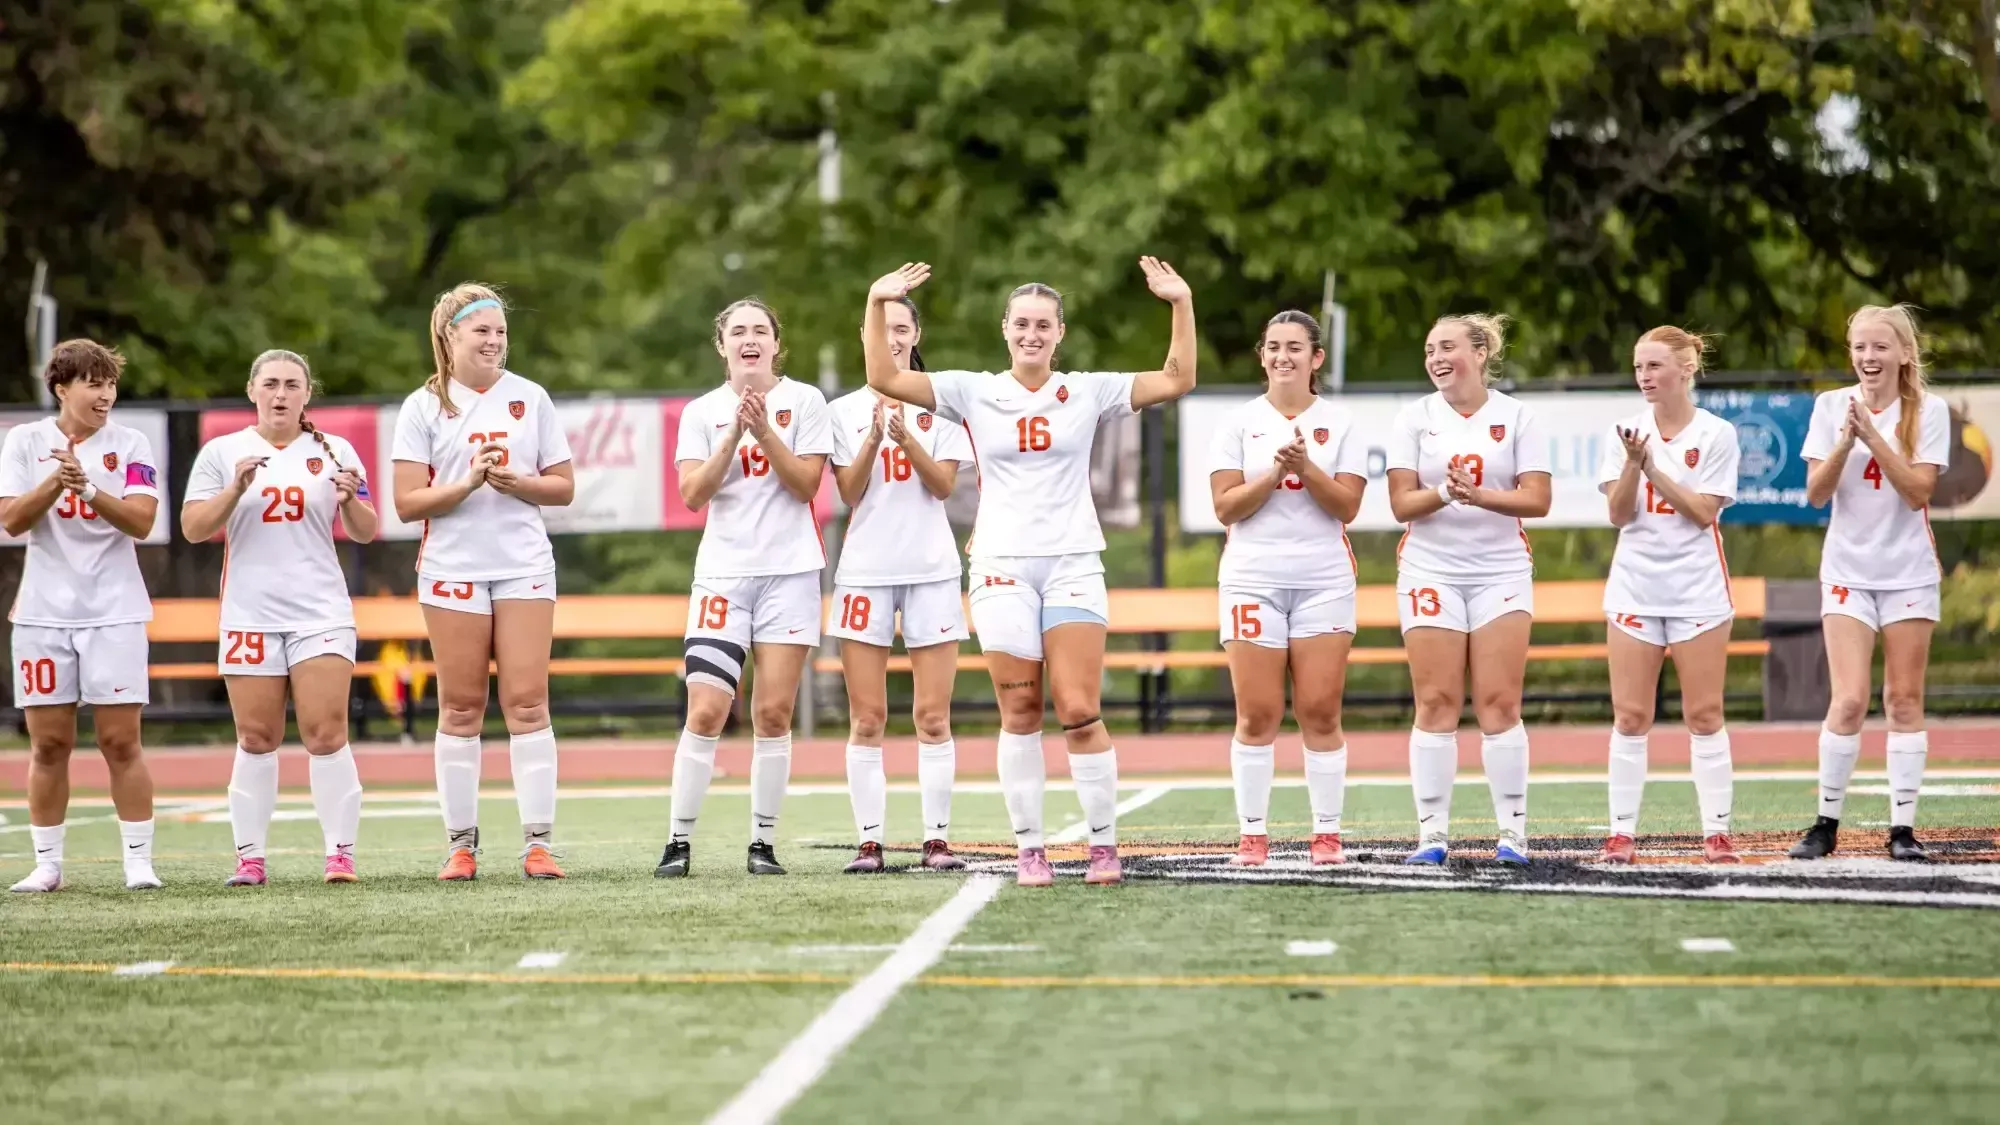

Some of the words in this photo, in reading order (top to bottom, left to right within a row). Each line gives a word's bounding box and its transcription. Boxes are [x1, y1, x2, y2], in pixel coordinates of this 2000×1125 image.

[1016, 416, 1051, 452] 16
[739, 445, 770, 478] 19
[880, 445, 913, 483] 18
[1863, 456, 1883, 490] 4
[261, 486, 305, 524] 29
[697, 595, 728, 630] 19
[840, 594, 871, 632] 18
[1409, 587, 1441, 617] 13
[1231, 603, 1262, 640] 15
[225, 631, 265, 665] 29
[20, 658, 56, 695] 30
